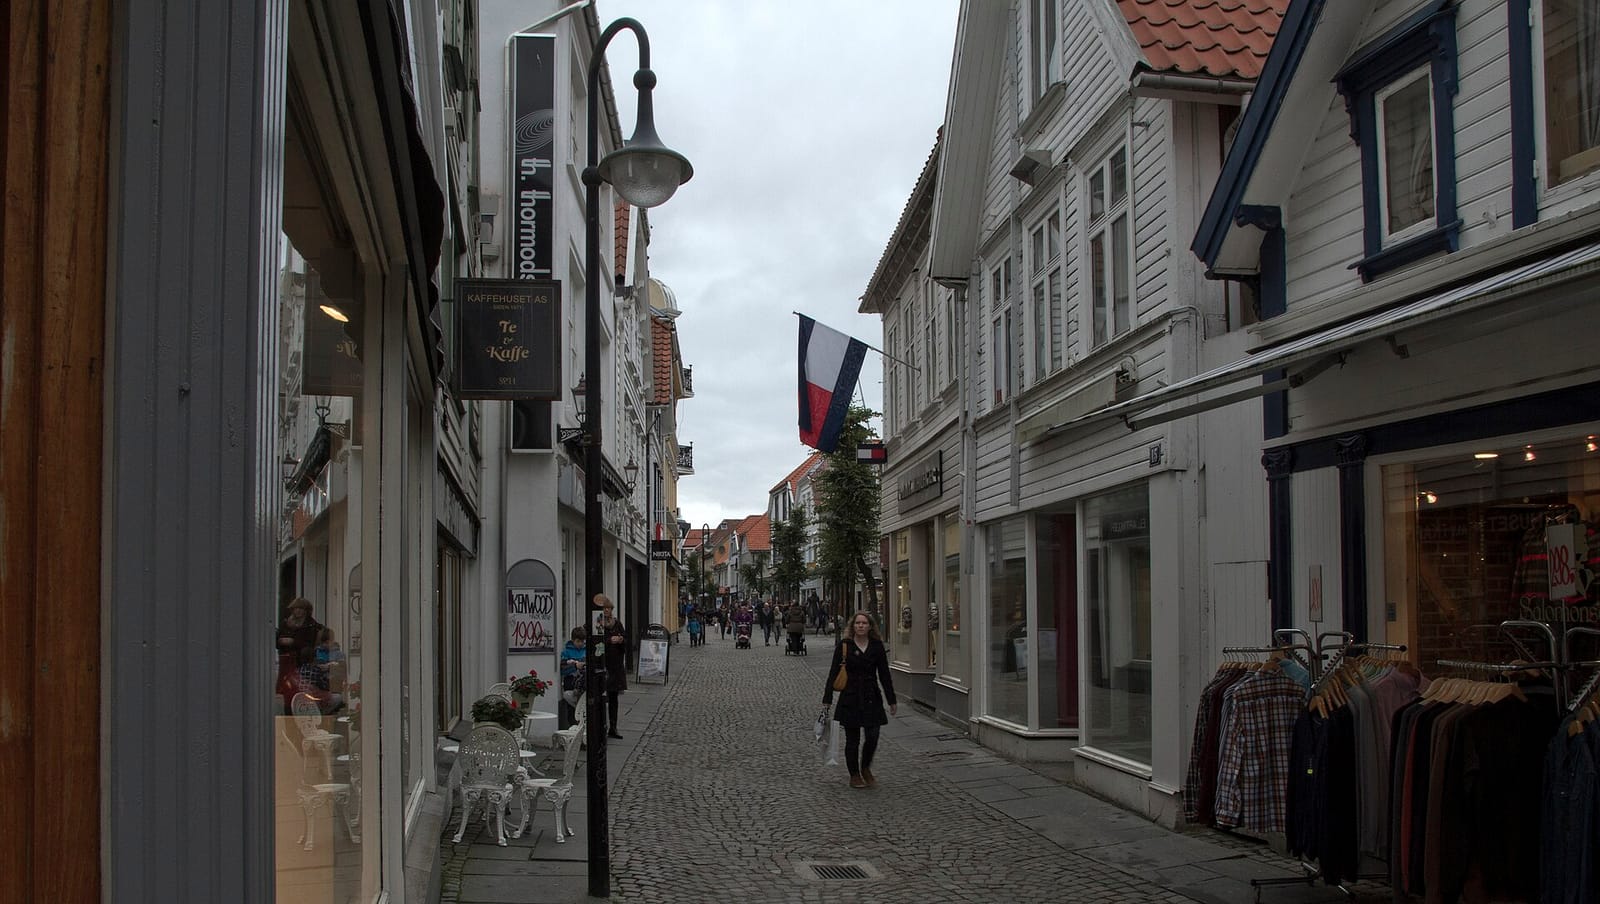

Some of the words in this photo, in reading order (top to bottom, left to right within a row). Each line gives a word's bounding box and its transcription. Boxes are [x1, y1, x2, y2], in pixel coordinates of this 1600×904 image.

[520, 157, 552, 181] th.
[467, 294, 531, 304] KAFFEHUSET
[534, 295, 548, 304] AS
[498, 319, 518, 333] Te
[486, 345, 530, 362] Kaffe
[511, 593, 553, 615] KENWOOD
